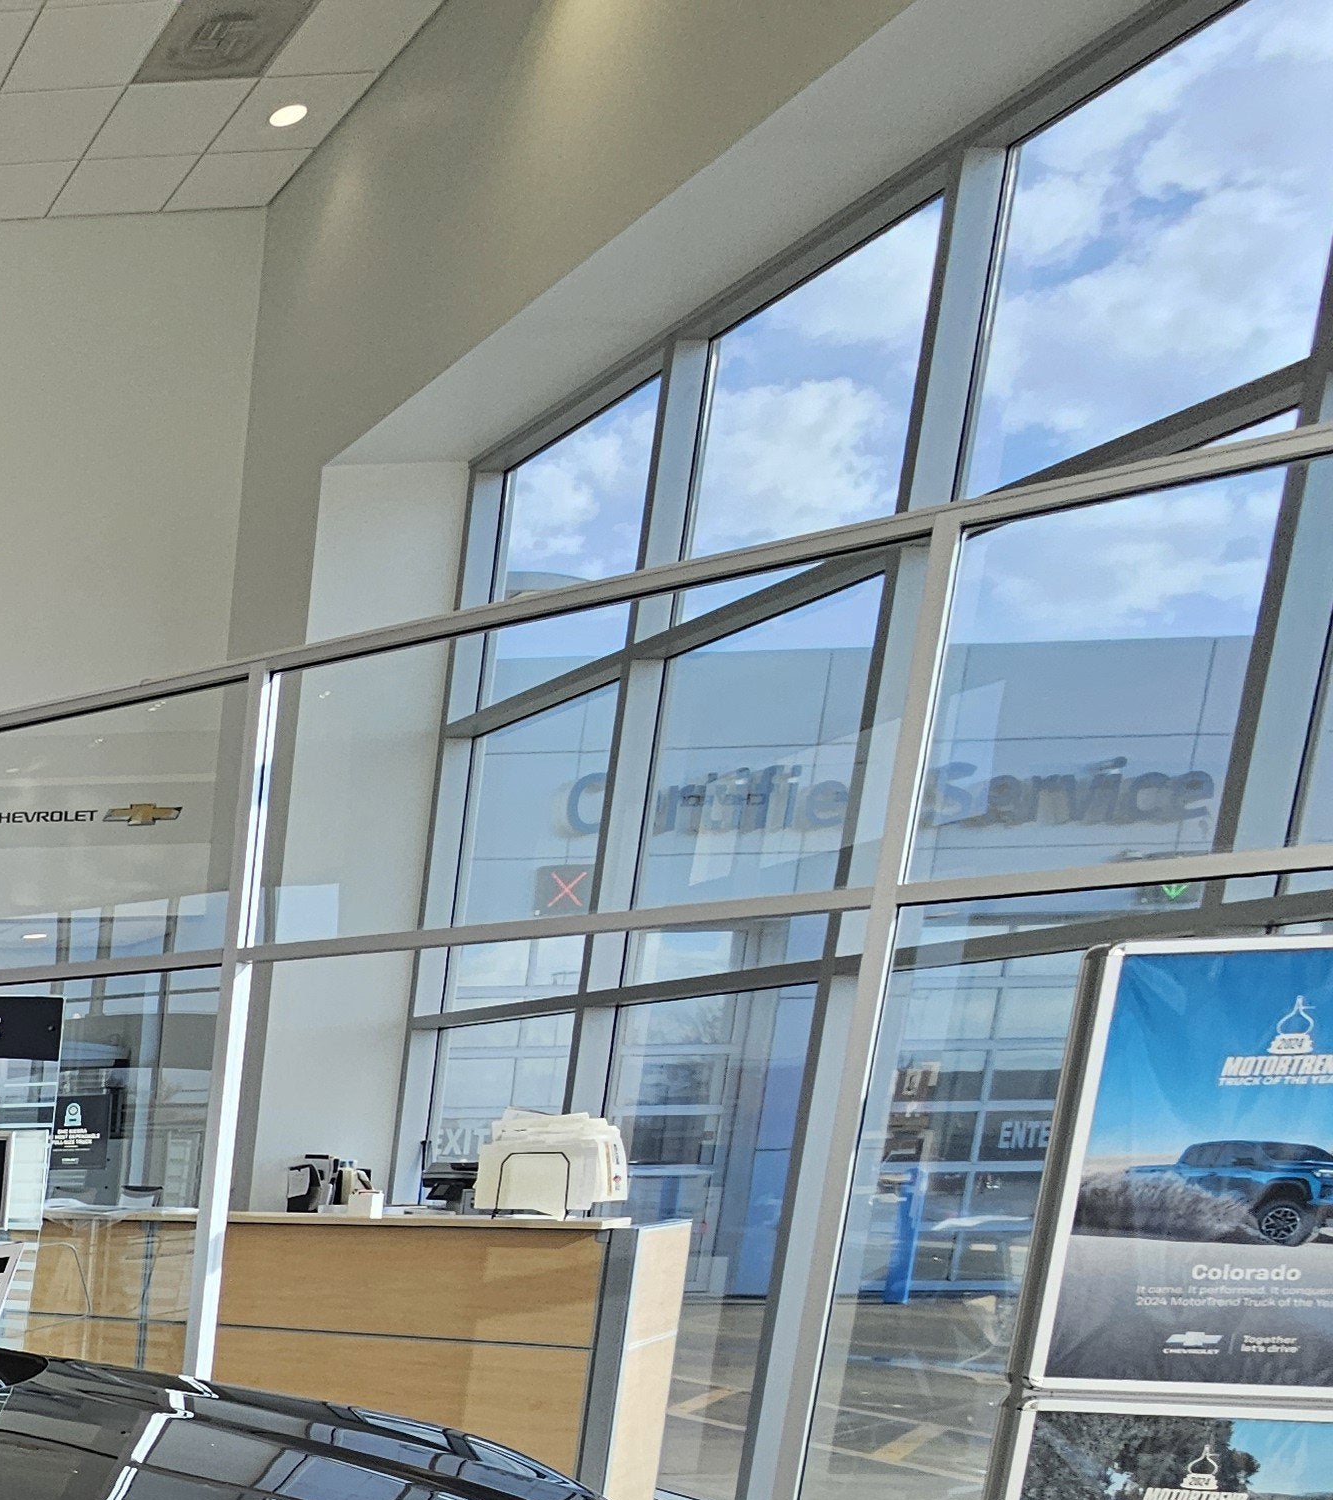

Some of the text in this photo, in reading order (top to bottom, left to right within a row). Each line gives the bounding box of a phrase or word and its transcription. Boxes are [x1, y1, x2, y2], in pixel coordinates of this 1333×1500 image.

[930, 756, 1215, 826] Service
[998, 1120, 1052, 1149] ENTE
[1191, 1264, 1302, 1281] Colorado
[1243, 1334, 1297, 1345] Together
